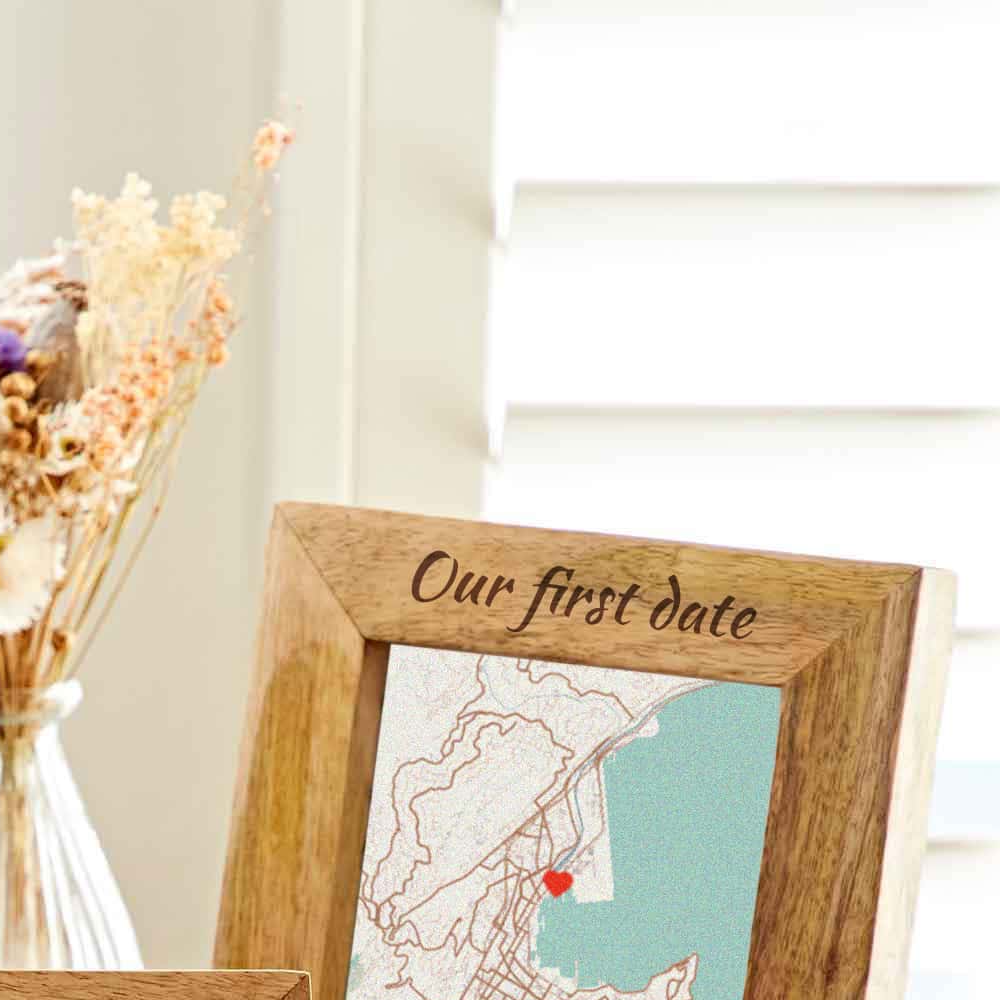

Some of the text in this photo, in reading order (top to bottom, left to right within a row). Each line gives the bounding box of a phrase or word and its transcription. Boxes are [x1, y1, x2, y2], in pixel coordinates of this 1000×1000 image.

[411, 550, 758, 639] Our first date
